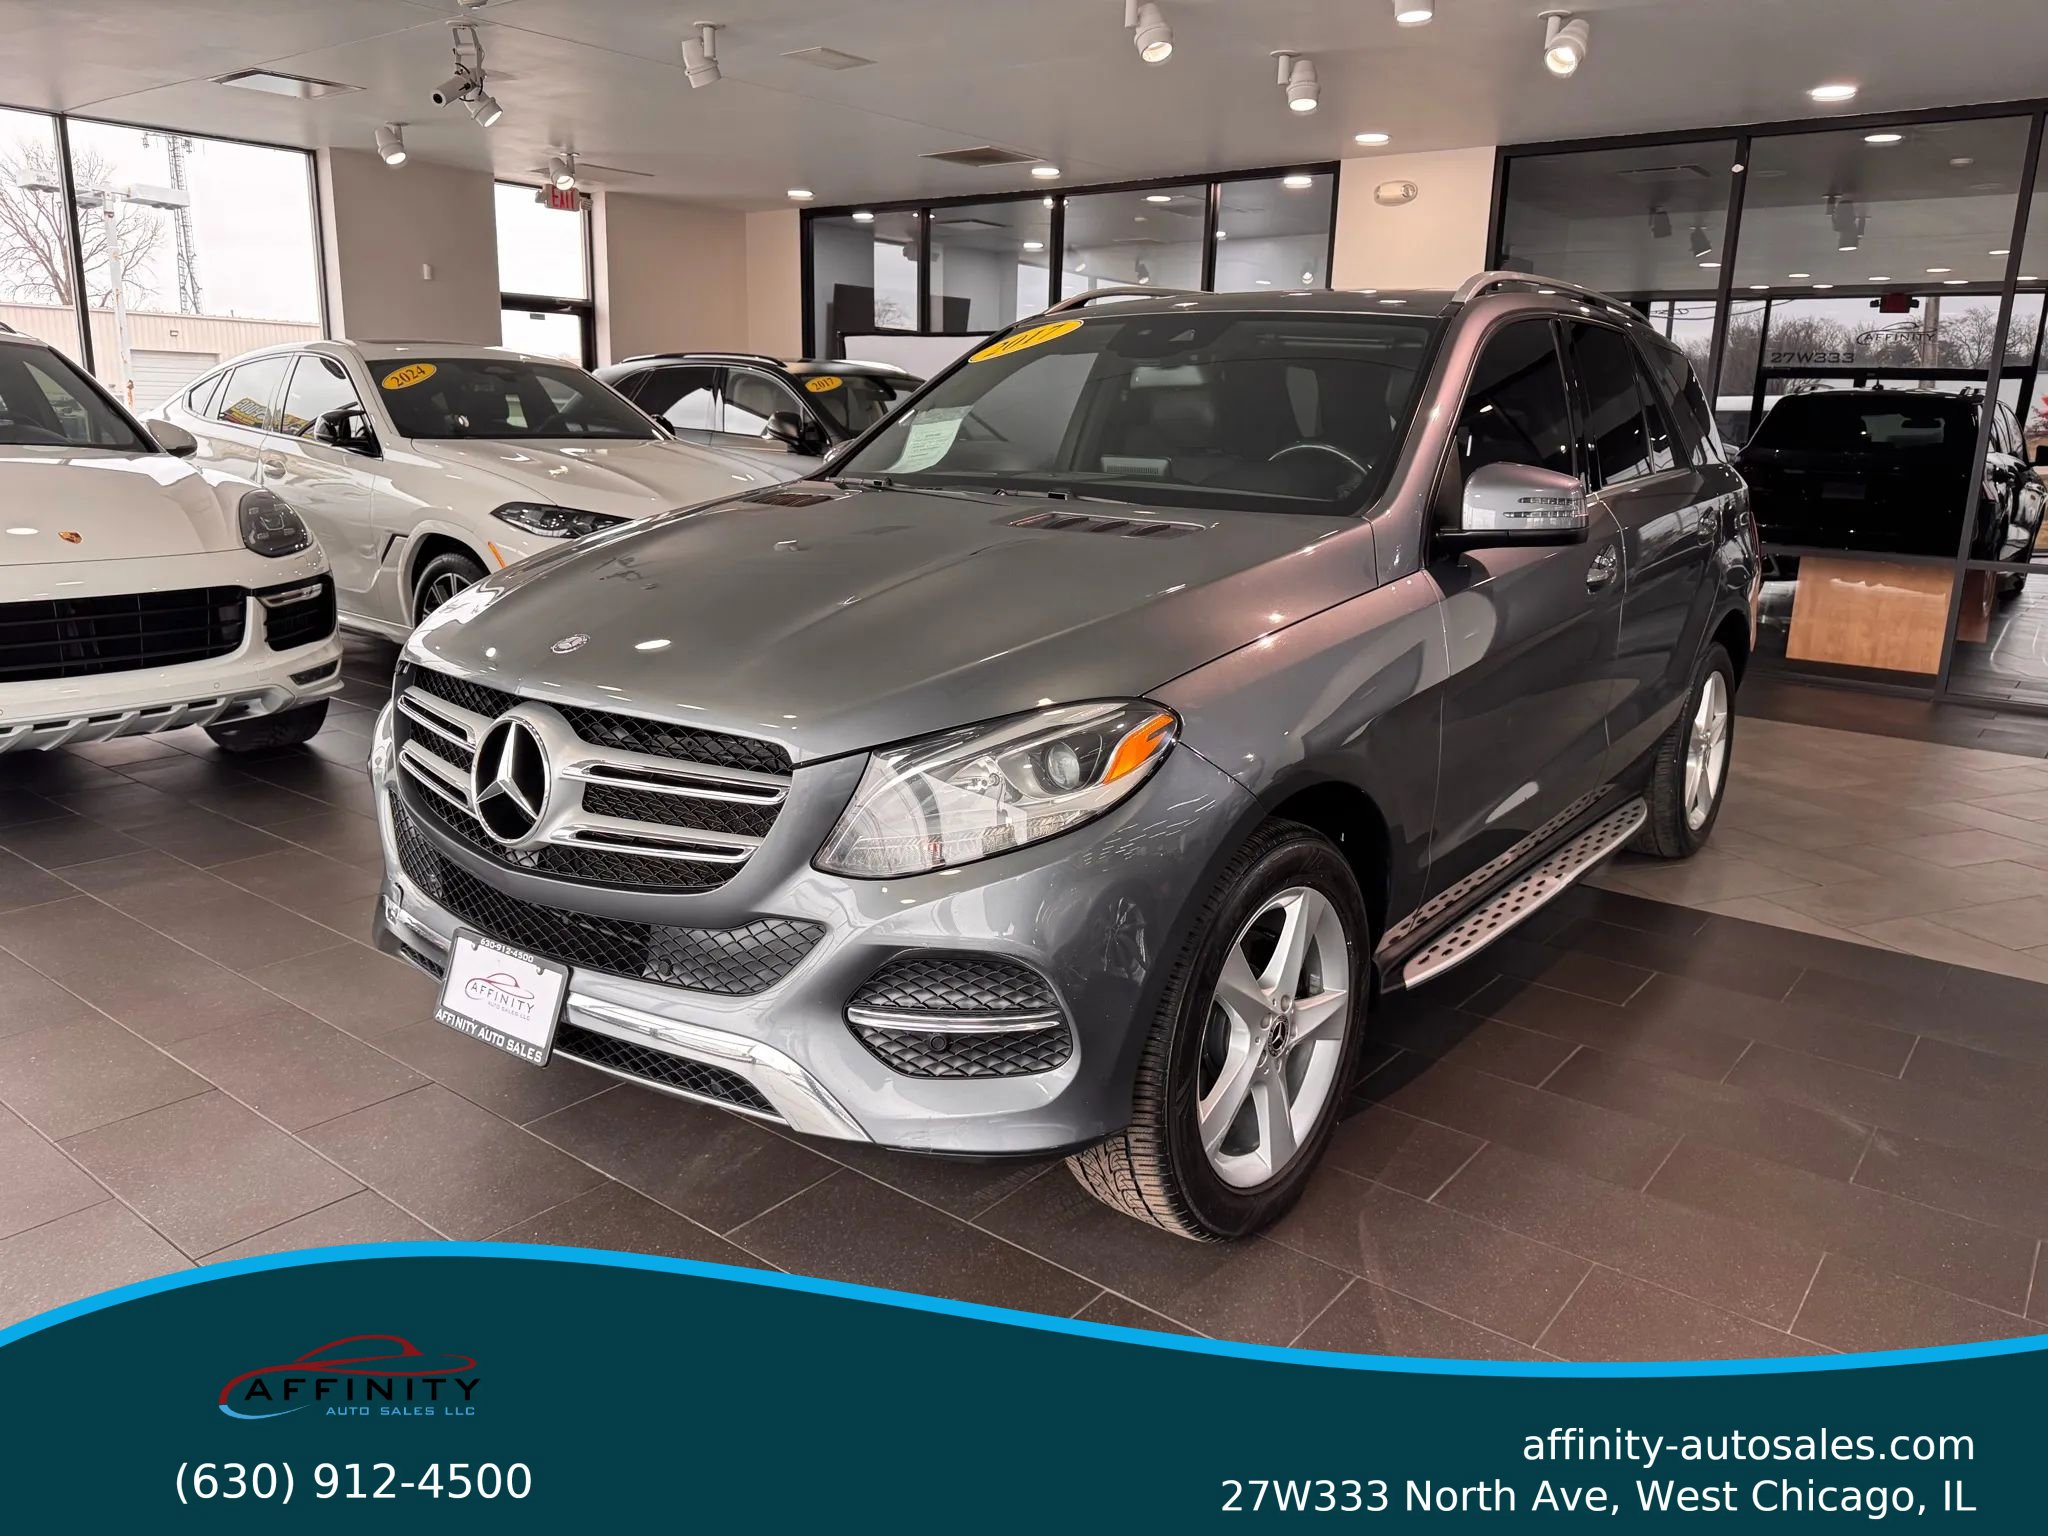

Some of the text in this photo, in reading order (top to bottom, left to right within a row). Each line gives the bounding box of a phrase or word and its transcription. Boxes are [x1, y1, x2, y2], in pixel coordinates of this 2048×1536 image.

[552, 188, 576, 209] EXIT
[983, 321, 1068, 358] 2017
[1864, 333, 1936, 342] AFFINITY
[1771, 352, 1855, 364] 27W333
[390, 365, 426, 387] 2024
[811, 377, 834, 391] 2017
[480, 938, 534, 963] 630-912-4500
[470, 982, 535, 1014] AFFINITY
[435, 1009, 543, 1063] AFFINITY AUTO SALES
